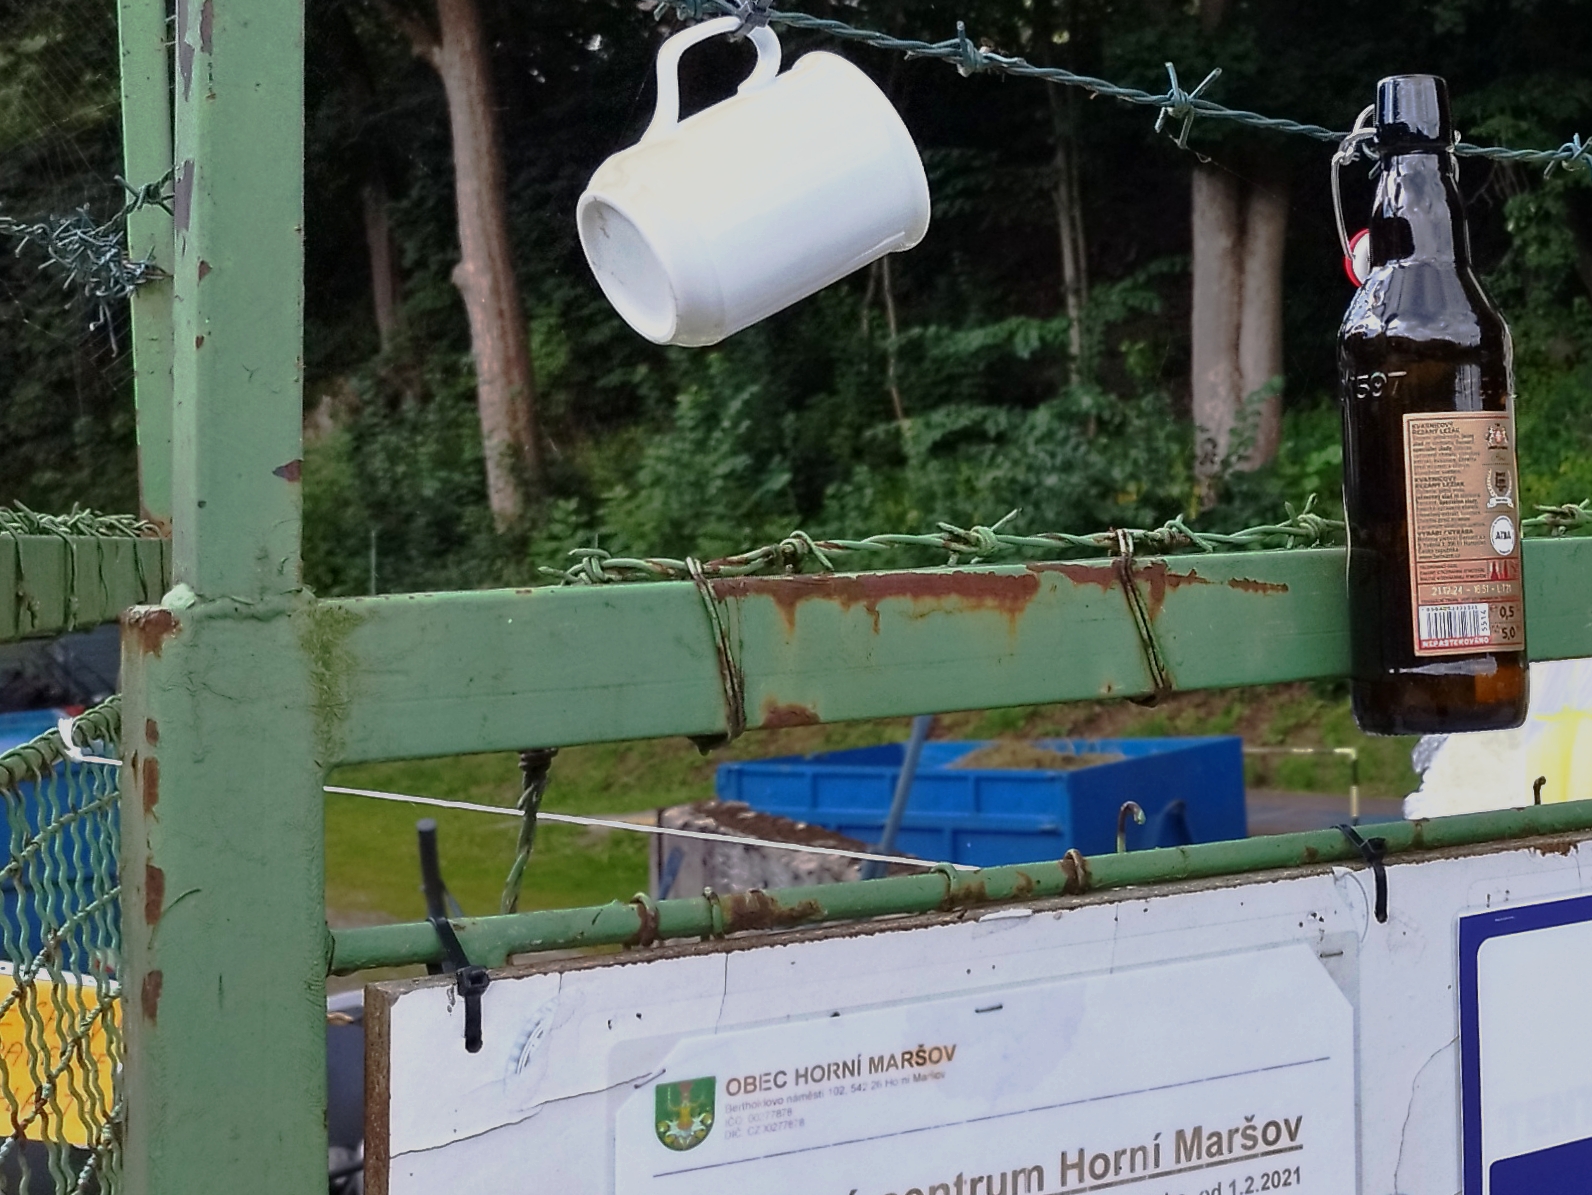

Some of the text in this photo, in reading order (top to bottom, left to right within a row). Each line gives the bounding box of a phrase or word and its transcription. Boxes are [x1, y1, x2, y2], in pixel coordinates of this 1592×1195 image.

[726, 1044, 957, 1096] OBEC HORNÍ MARŠOV
[885, 1074, 911, 1087] Honí
[885, 1114, 1303, 1195] trum Horní Maršov
[1228, 1166, 1301, 1195] 1.2.2021
